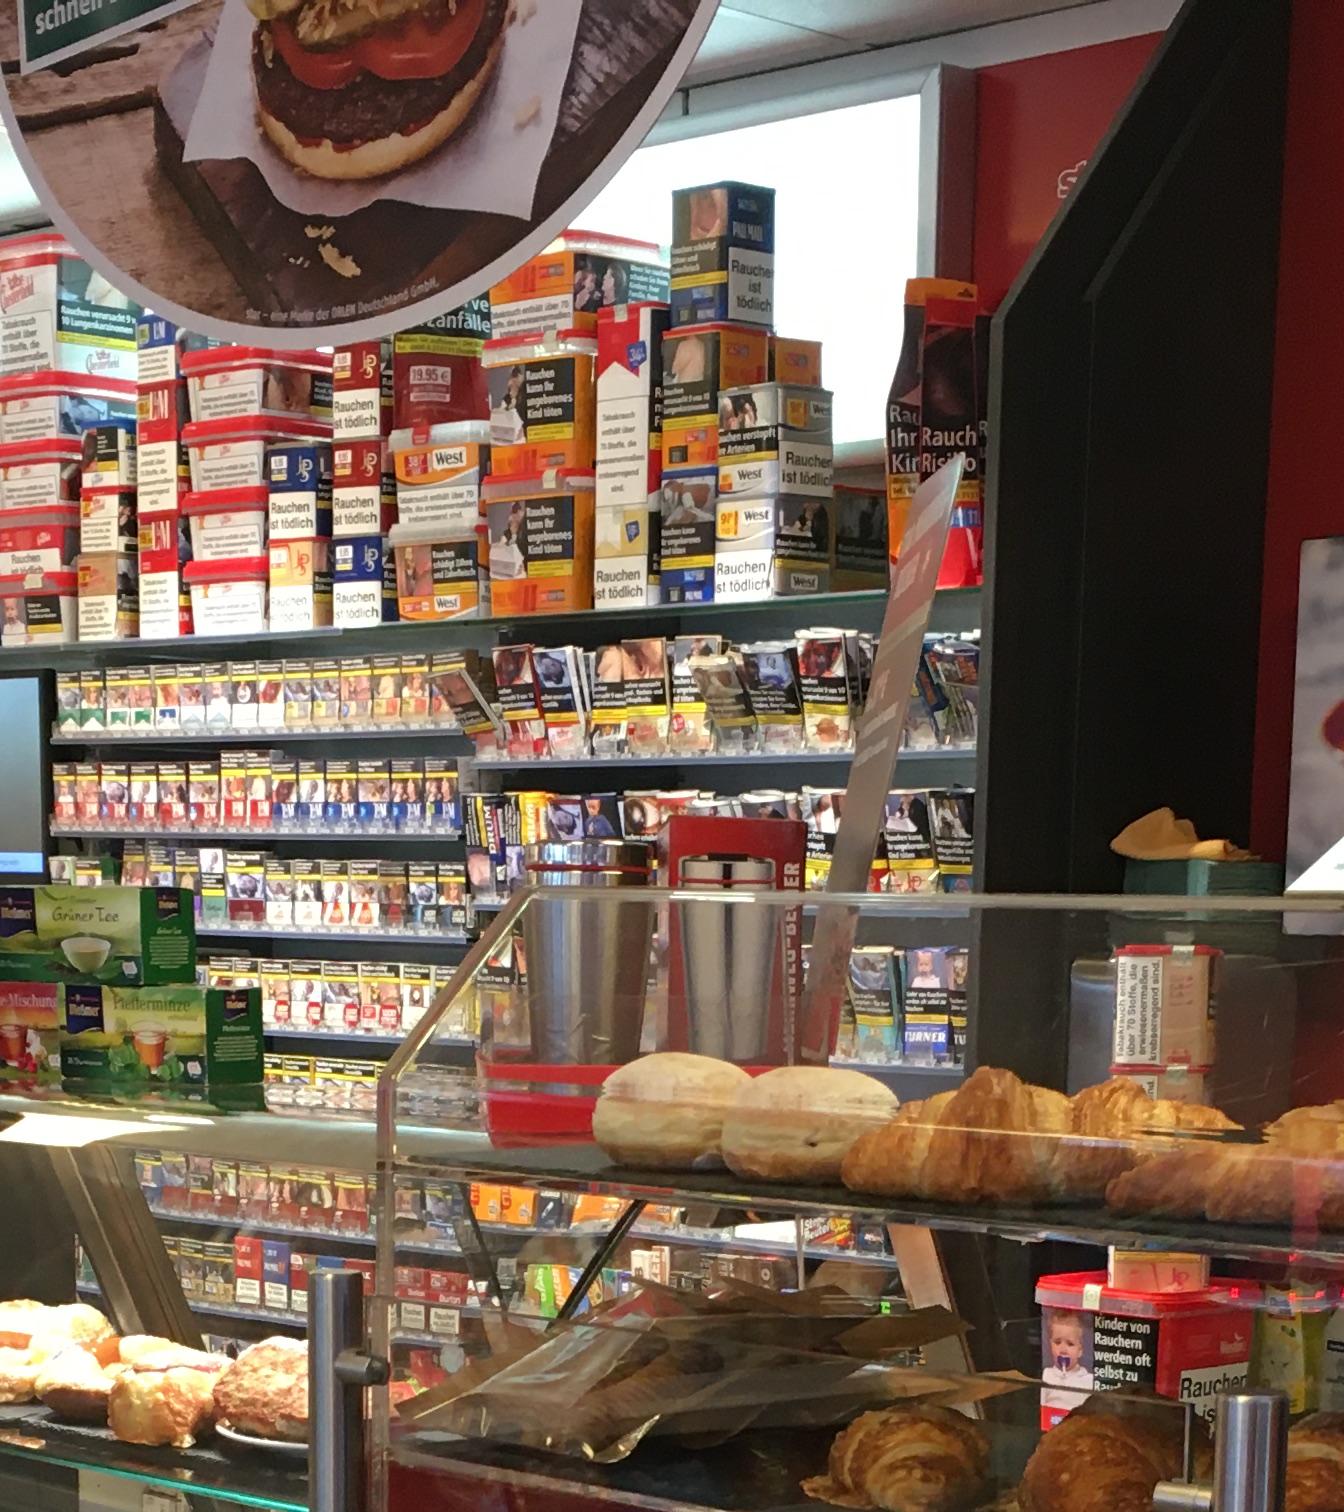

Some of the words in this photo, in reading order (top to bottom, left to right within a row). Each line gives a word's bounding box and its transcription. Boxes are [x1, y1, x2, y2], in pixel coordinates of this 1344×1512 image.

[749, 282, 761, 294] ist
[737, 296, 772, 312] tödlich
[412, 369, 438, 381] 19.95
[335, 399, 374, 413] Rauchen
[344, 415, 377, 428] tödlich
[891, 427, 917, 448] Ihr
[922, 425, 977, 446] Rauch
[435, 451, 463, 465] West
[271, 502, 310, 515] Rauchen
[335, 497, 374, 510] Rauchen
[280, 517, 313, 529] tödlich
[344, 513, 377, 525] tödlich
[597, 571, 640, 583] Rauchen
[608, 585, 643, 599] tödlich
[730, 579, 770, 592] tödlich
[346, 606, 379, 619] tödlich
[52, 906, 94, 922] Grüner
[96, 907, 119, 922] Tee
[1095, 1314, 1127, 1331] Kinder
[1130, 1322, 1150, 1334] von
[1095, 1332, 1142, 1350] Rauchern
[1094, 1351, 1132, 1365] werden
[1135, 1353, 1151, 1367] oft
[1094, 1367, 1124, 1380] selbst
